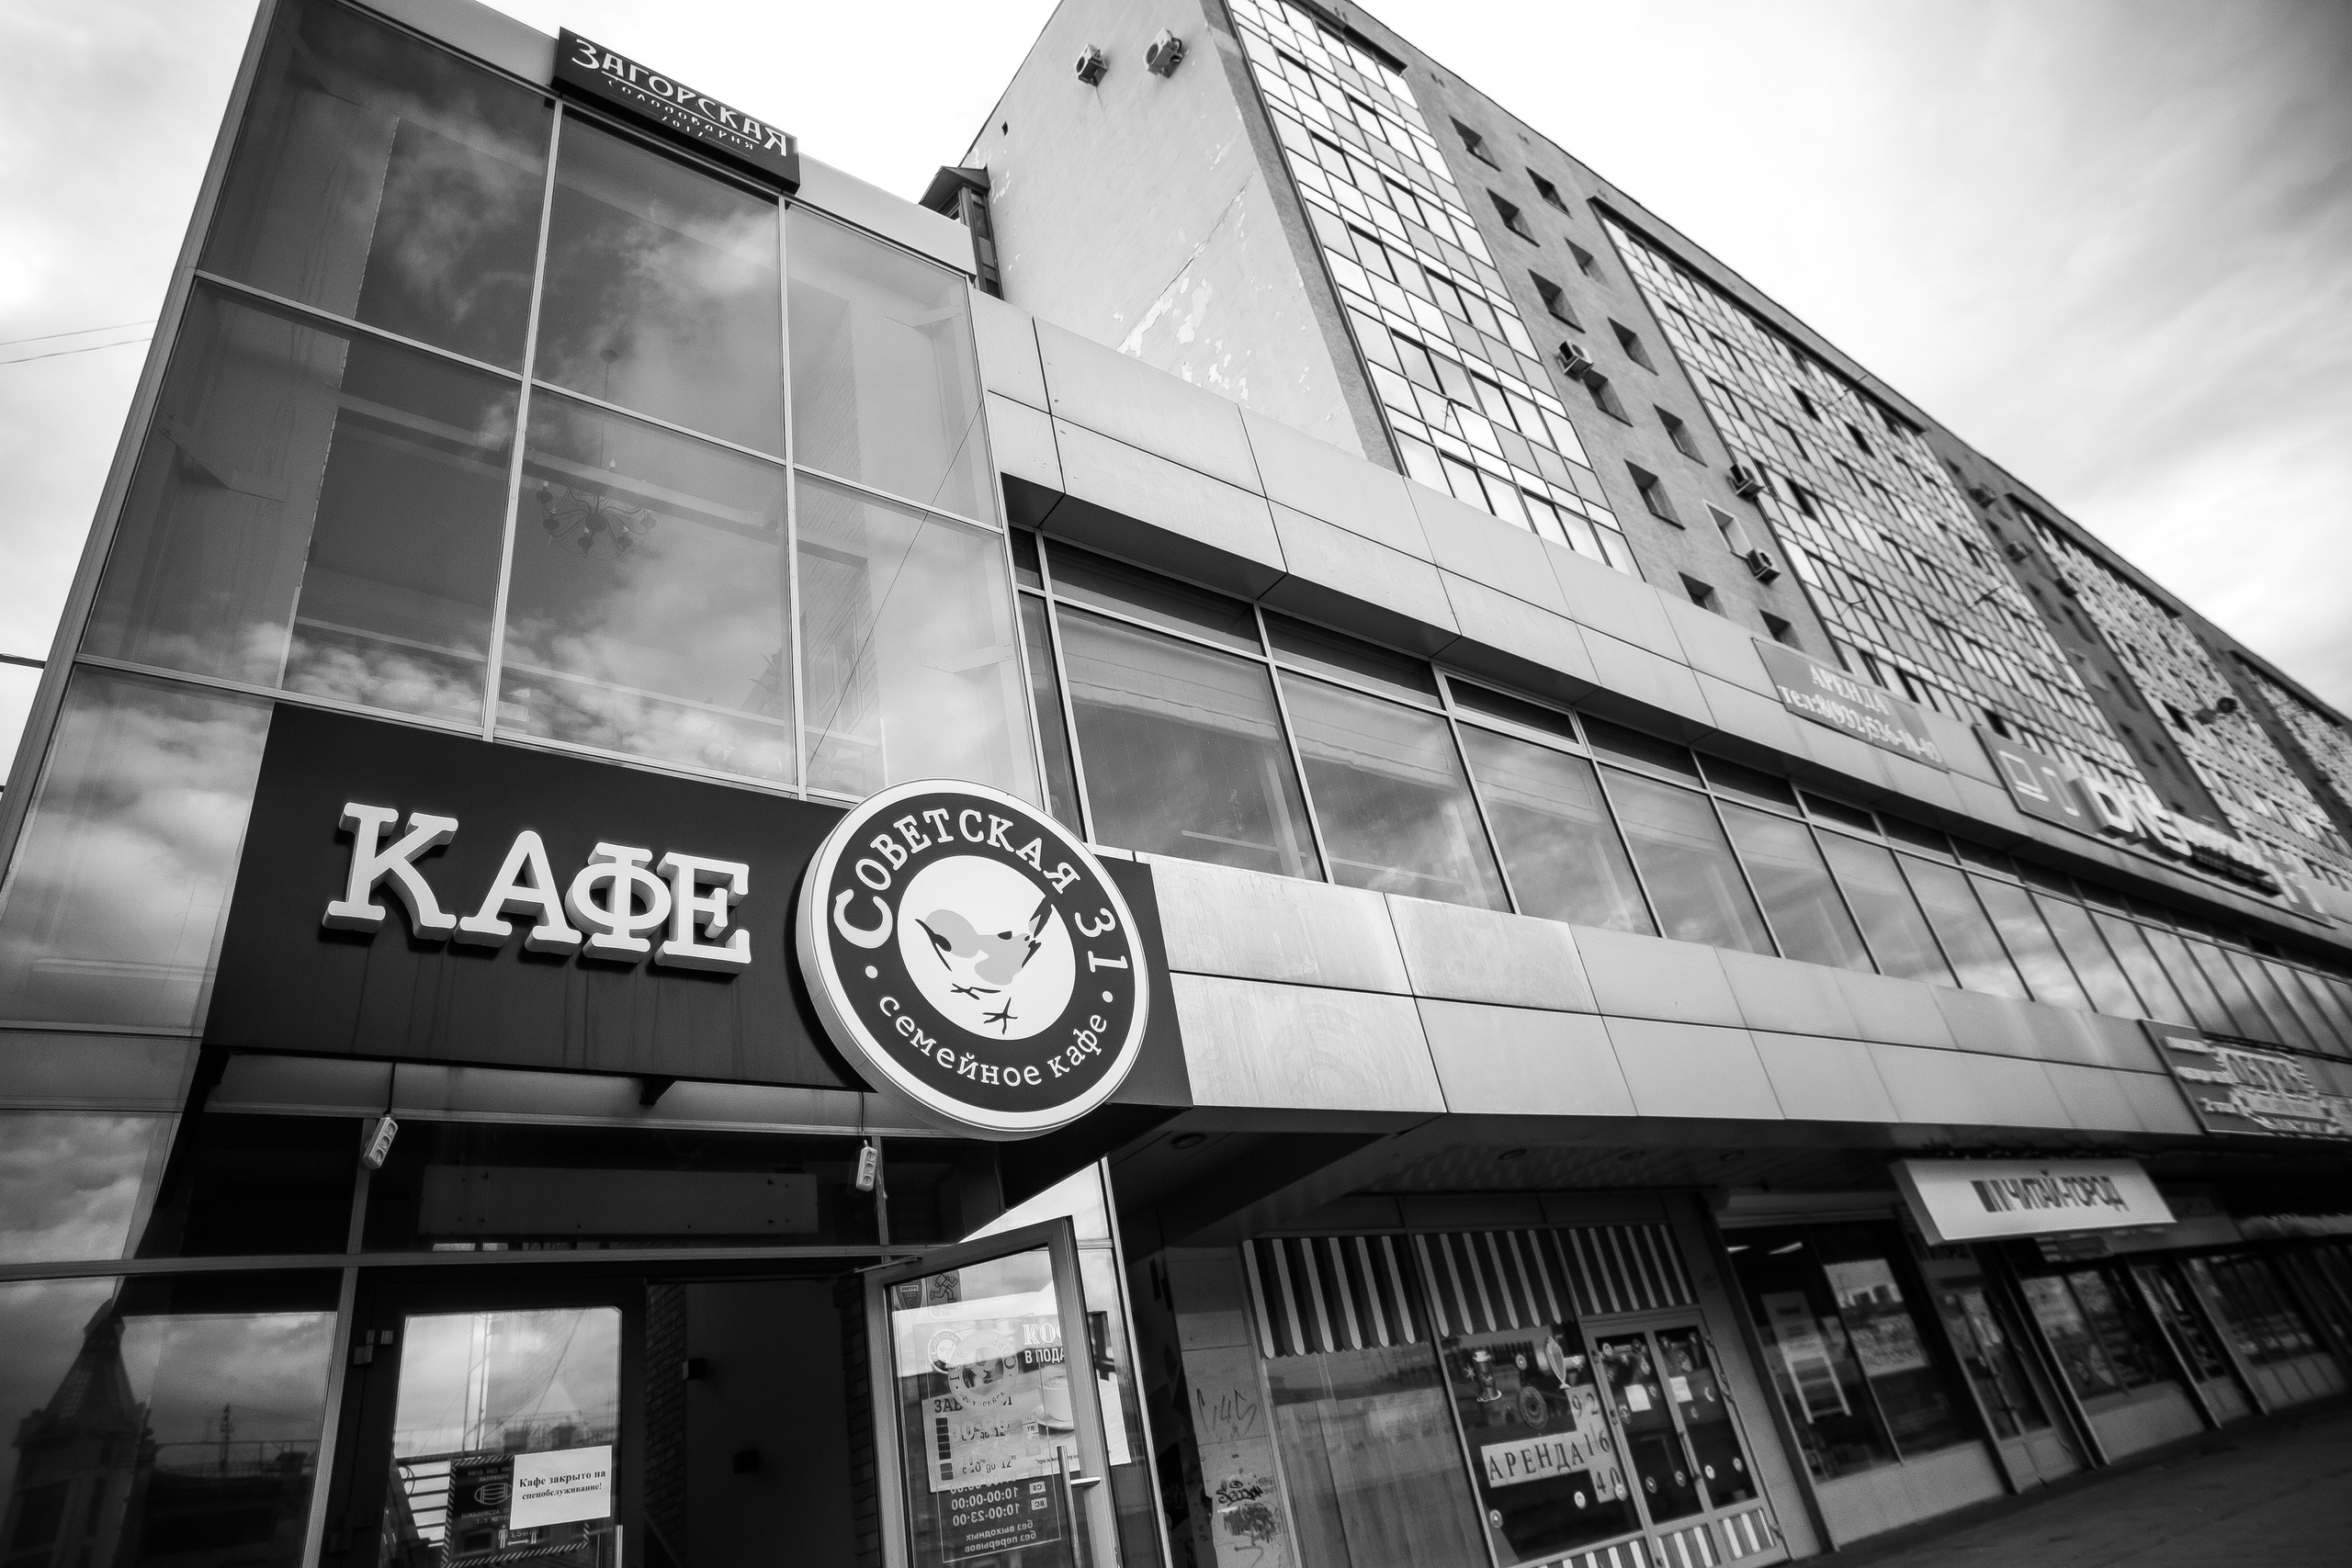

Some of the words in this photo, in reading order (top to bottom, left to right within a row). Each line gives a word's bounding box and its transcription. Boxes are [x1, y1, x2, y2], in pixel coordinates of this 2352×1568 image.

[571, 39, 787, 157] ЗАГОРСКАЯ
[1810, 663, 1890, 716] АРЕНДА
[323, 802, 752, 972] КАФЕ
[1073, 908, 1129, 973] 31
[878, 996, 1042, 1087] семейное
[1046, 1014, 1108, 1078] кафе
[1025, 1350, 1033, 1364] В
[519, 1477, 546, 1488] Кафе
[548, 1472, 592, 1484] закрыто
[594, 1470, 606, 1478] на
[1488, 1440, 1586, 1481] АРЕНДА
